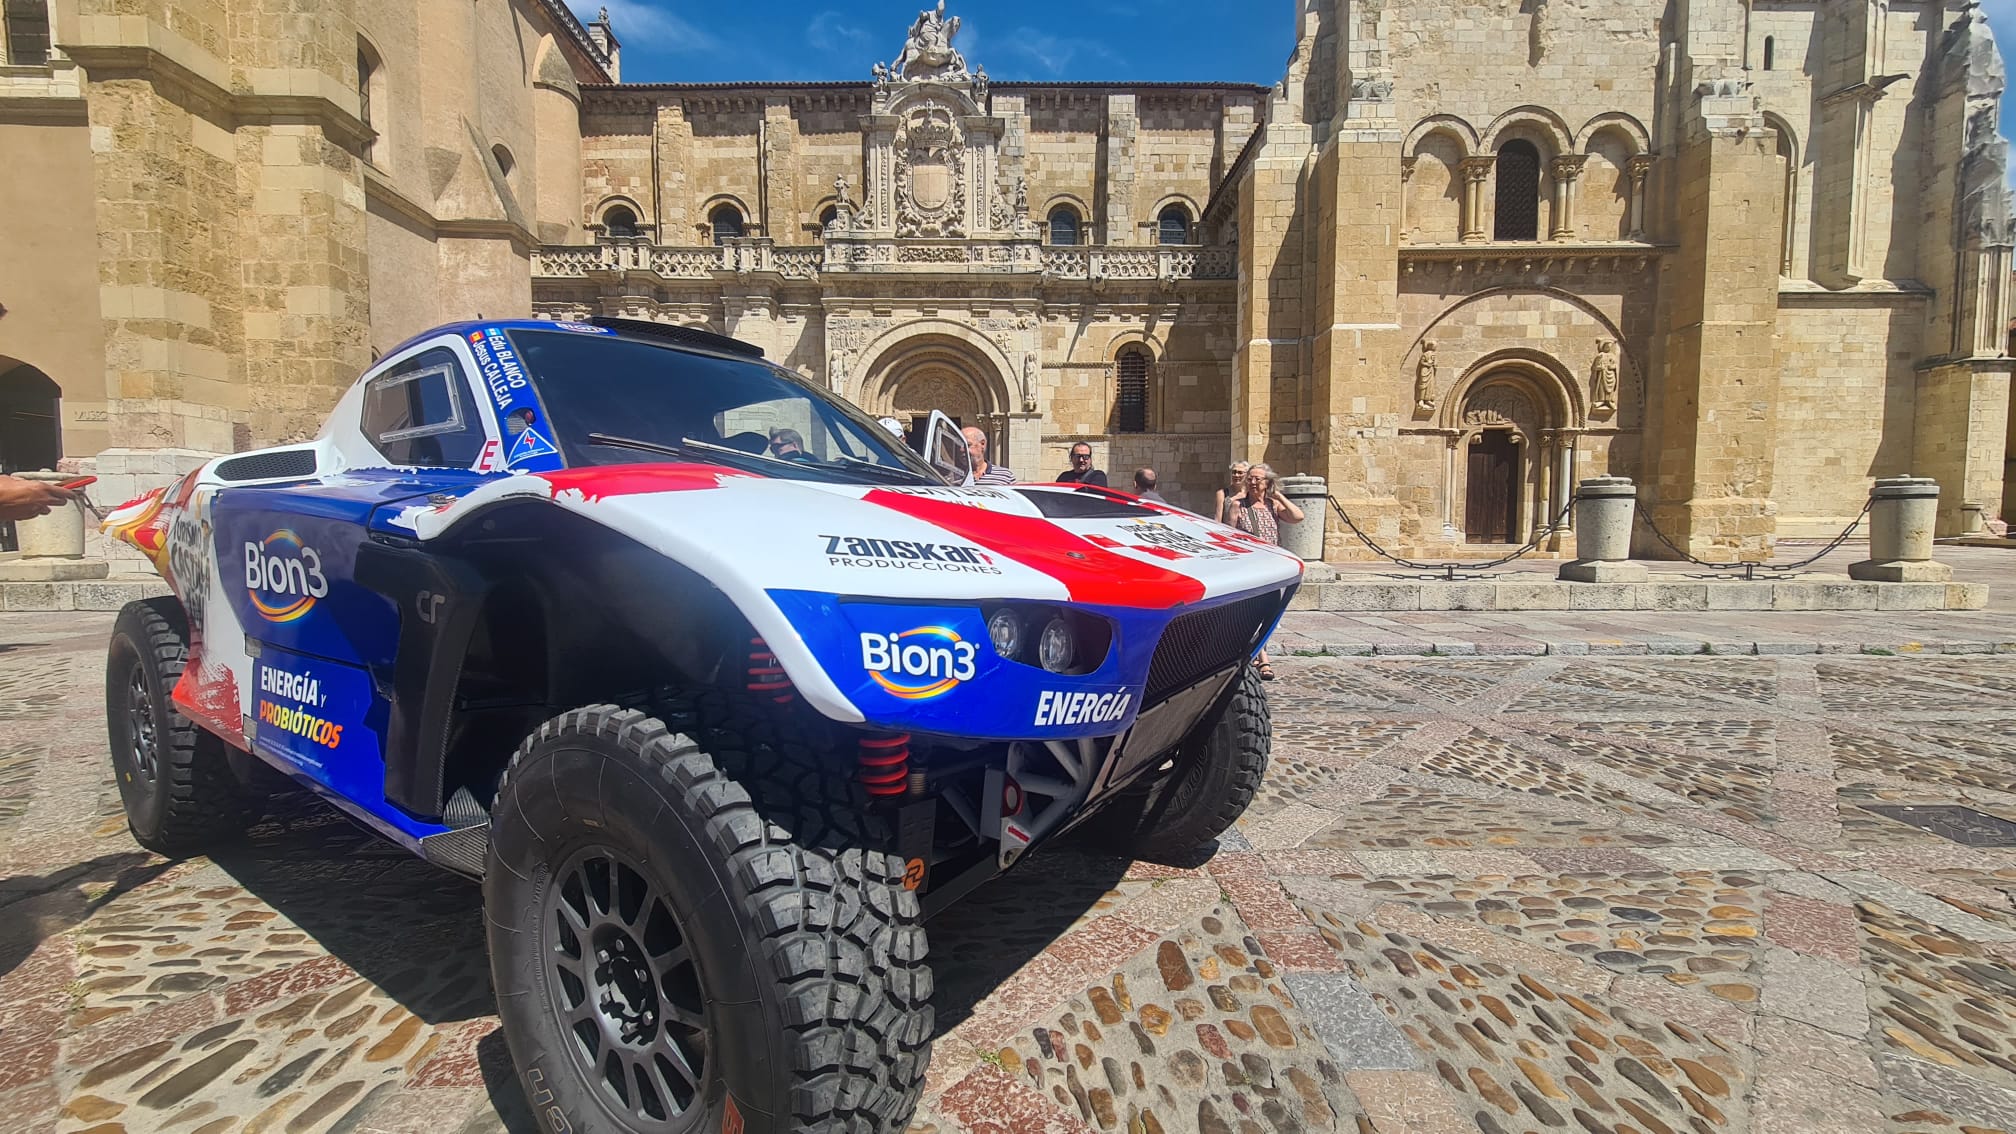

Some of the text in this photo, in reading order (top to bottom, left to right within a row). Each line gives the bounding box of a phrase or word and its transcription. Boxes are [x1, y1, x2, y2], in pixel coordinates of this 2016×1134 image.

[484, 362, 513, 410] CALLEJA
[488, 335, 527, 389] Edu BLANCO
[244, 541, 328, 599] Bion3
[828, 557, 1002, 575] PRODUCCIONES
[860, 632, 976, 681] Bion3
[261, 665, 318, 706] ENERGÍA
[1034, 686, 1131, 726] ENERGÍA
[259, 699, 344, 749] PROBIÓTICOS
